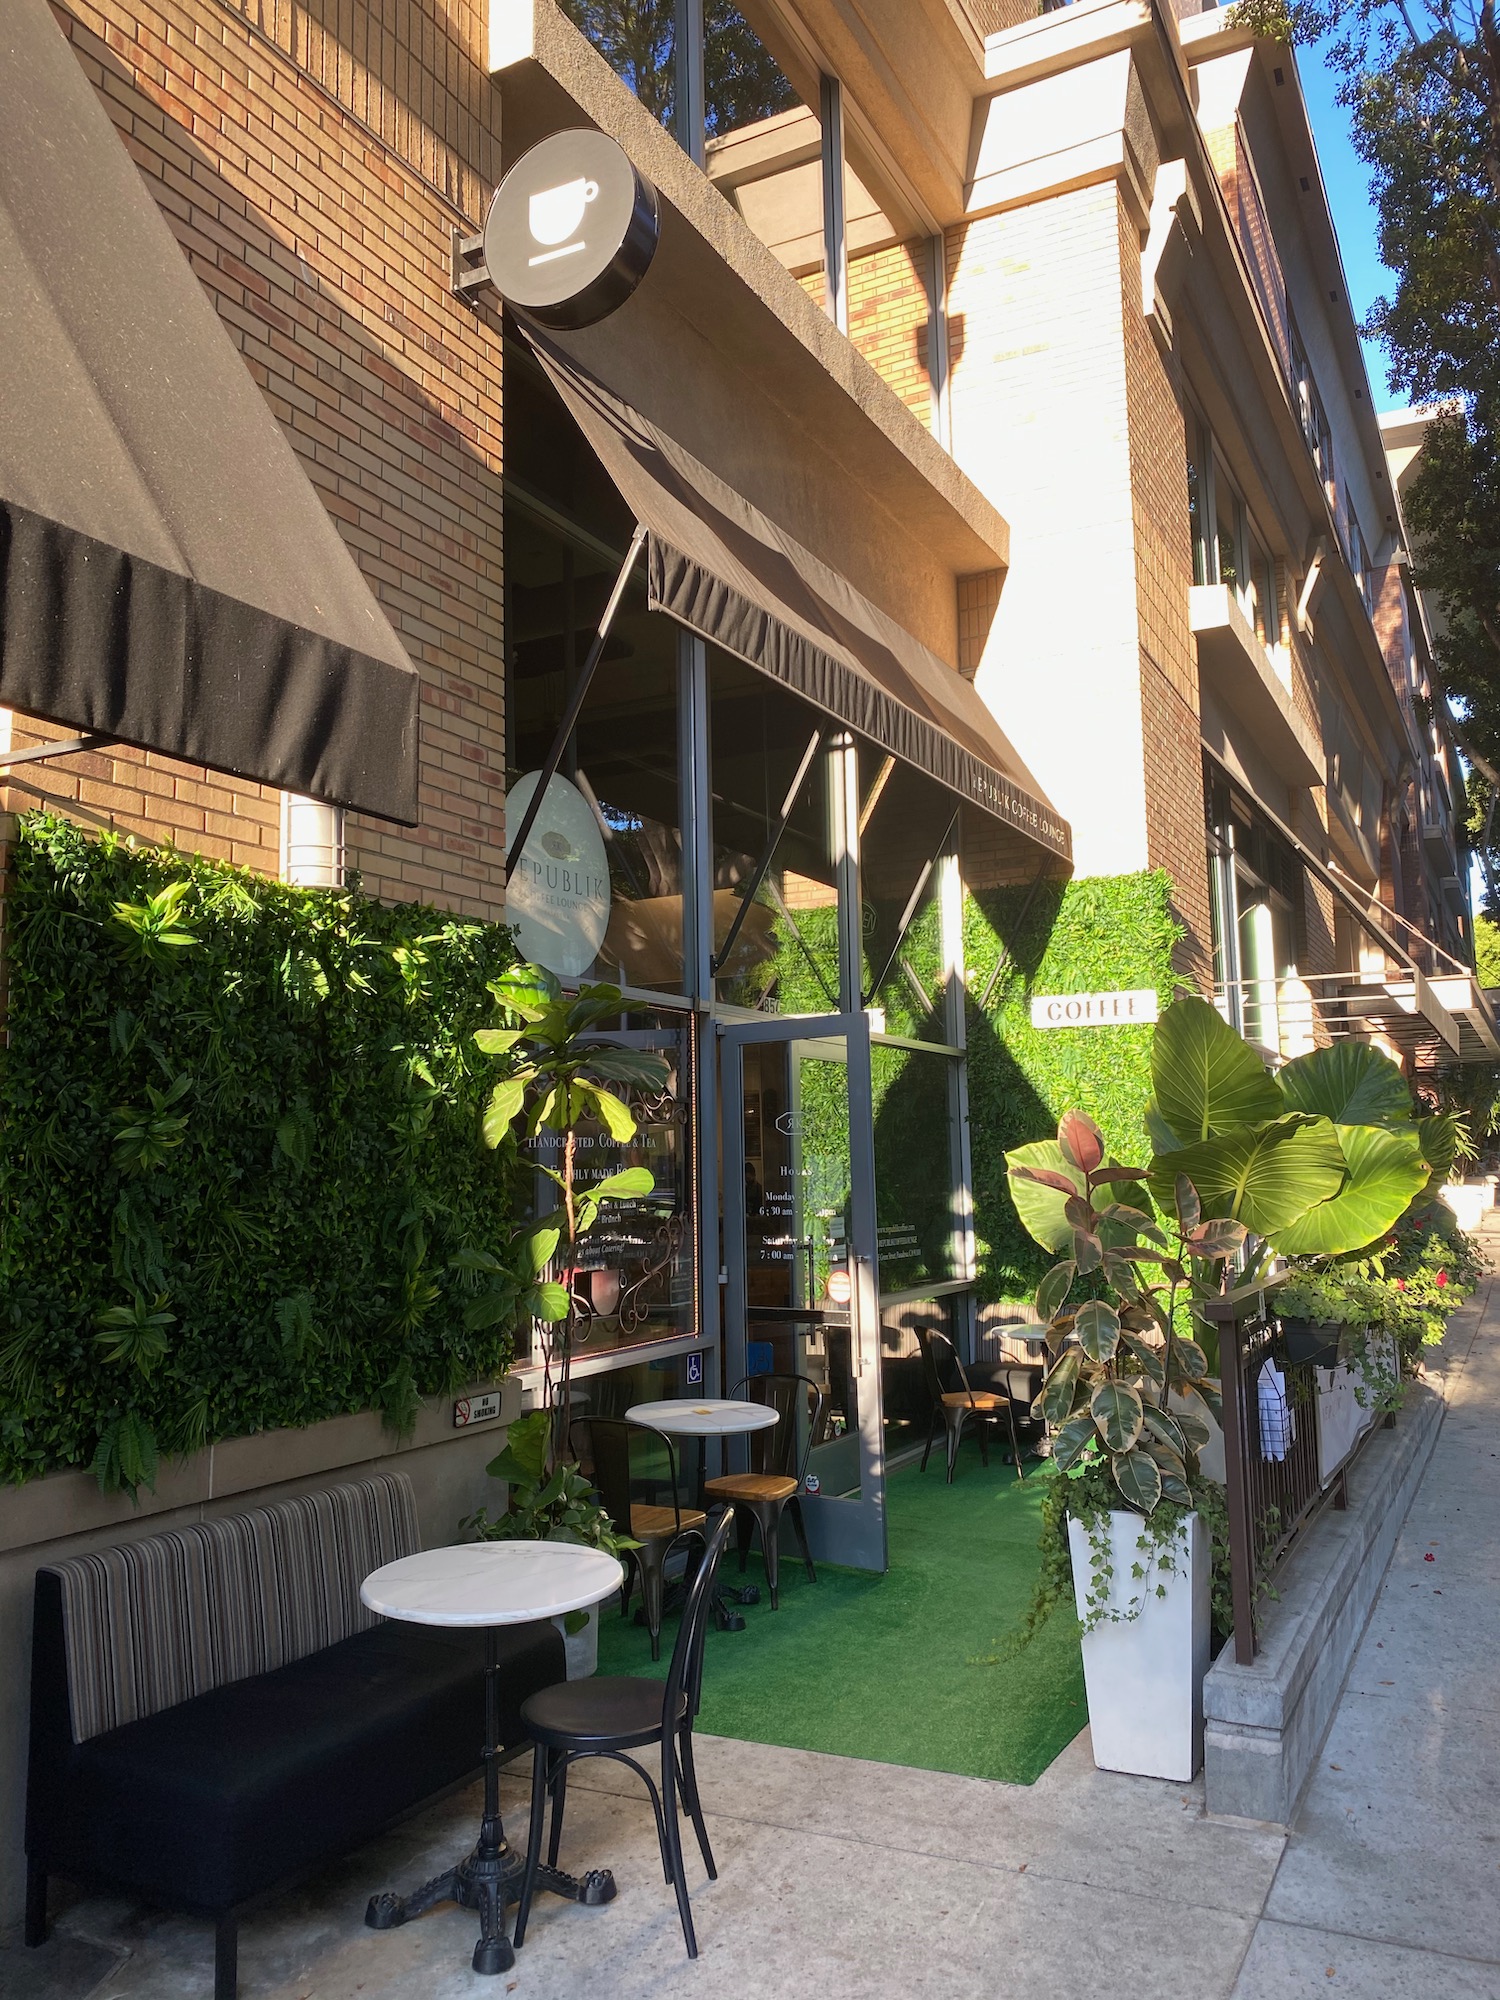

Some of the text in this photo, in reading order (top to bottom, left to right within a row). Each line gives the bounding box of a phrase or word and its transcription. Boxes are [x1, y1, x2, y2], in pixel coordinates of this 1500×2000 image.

[1012, 799, 1038, 828] COFFEE
[1039, 817, 1065, 845] LOUNGE
[519, 857, 604, 901] EPUBLIK
[1047, 997, 1140, 1021] COFFEE
[640, 1133, 656, 1148] TEA
[765, 1191, 796, 1203] Monday
[762, 1234, 798, 1247] Saturday
[482, 1397, 489, 1406] NO
[473, 1406, 496, 1419] SMOKING
